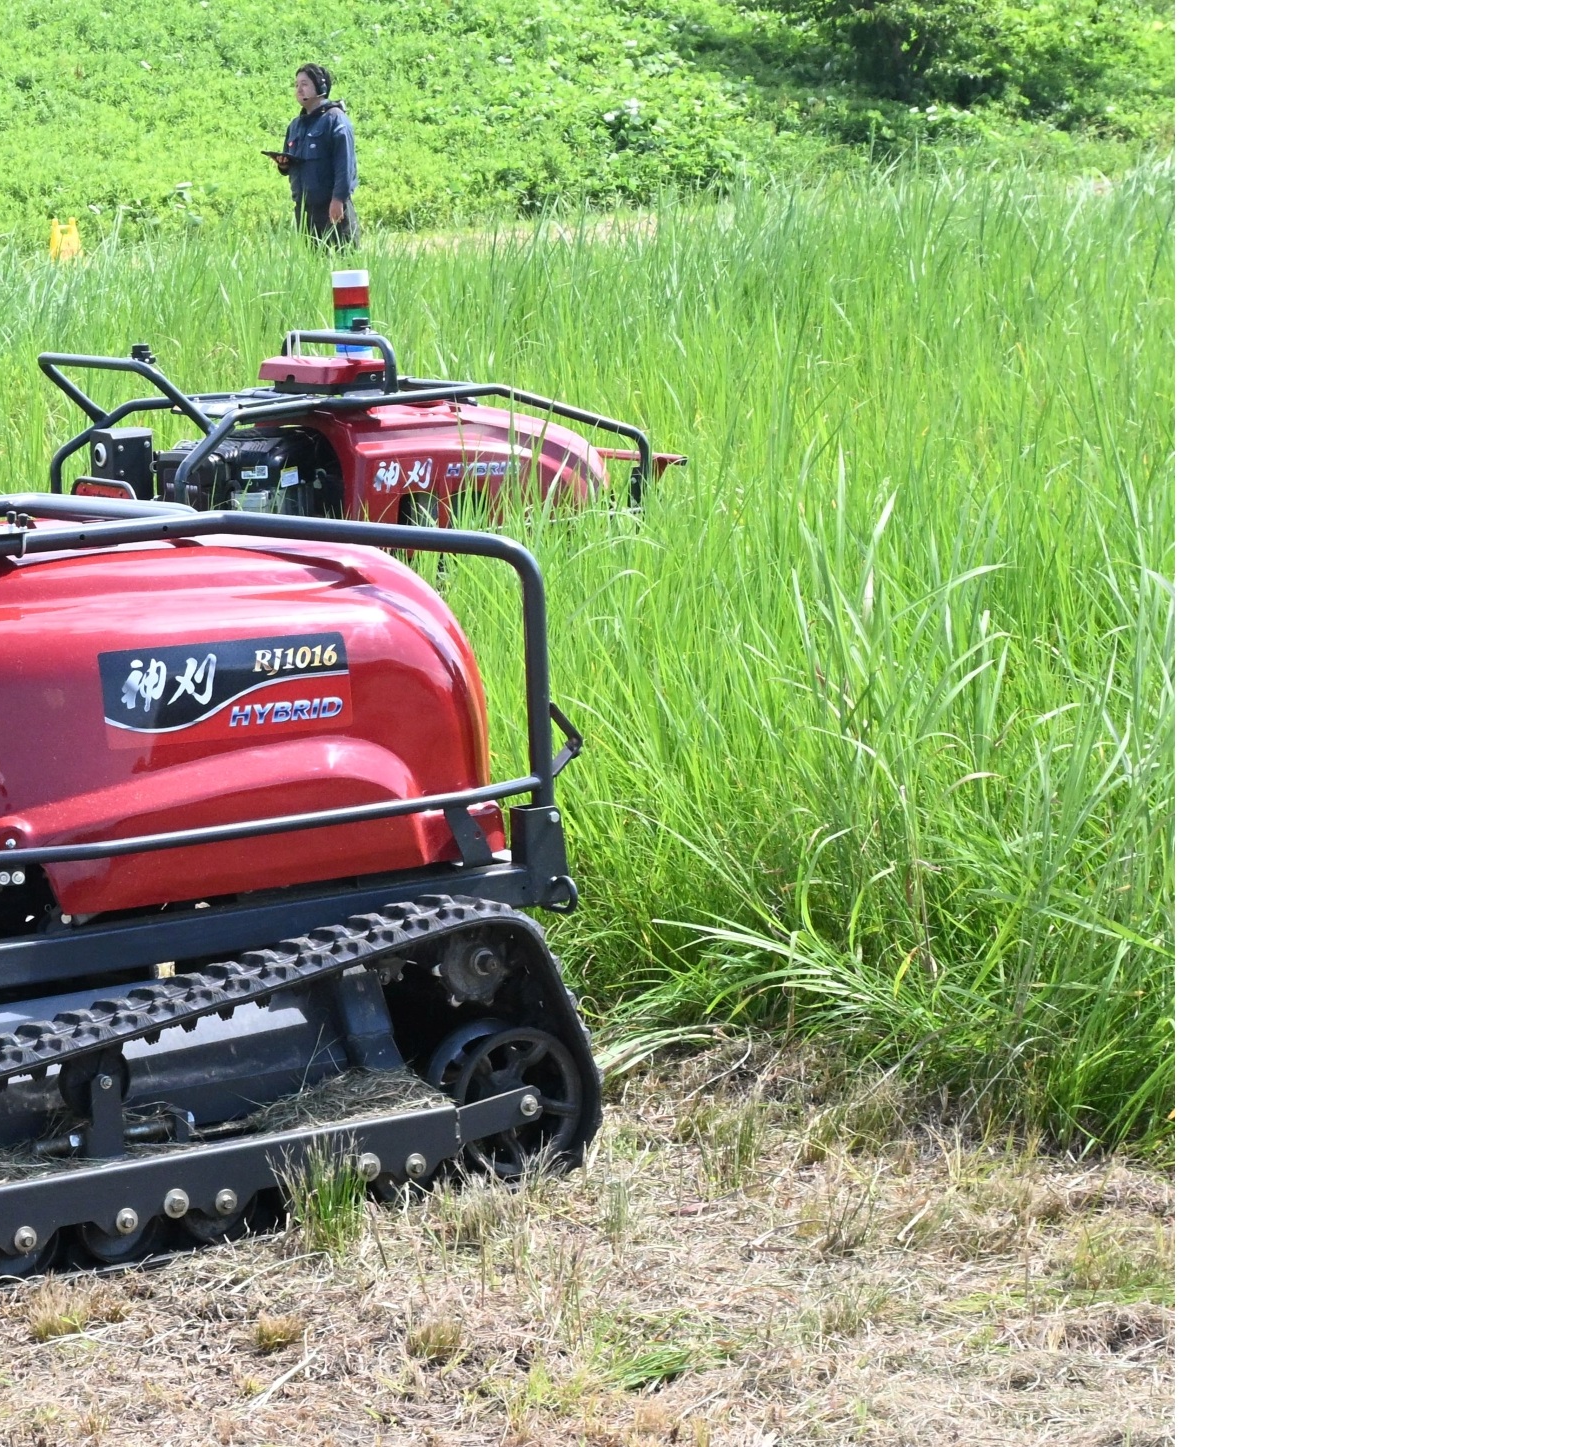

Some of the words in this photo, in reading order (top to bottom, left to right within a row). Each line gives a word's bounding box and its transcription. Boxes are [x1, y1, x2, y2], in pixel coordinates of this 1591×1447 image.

[373, 457, 433, 494] 神刈
[252, 644, 338, 676] RJ1016
[121, 653, 217, 712] 神刈
[229, 696, 343, 727] HYBRID
